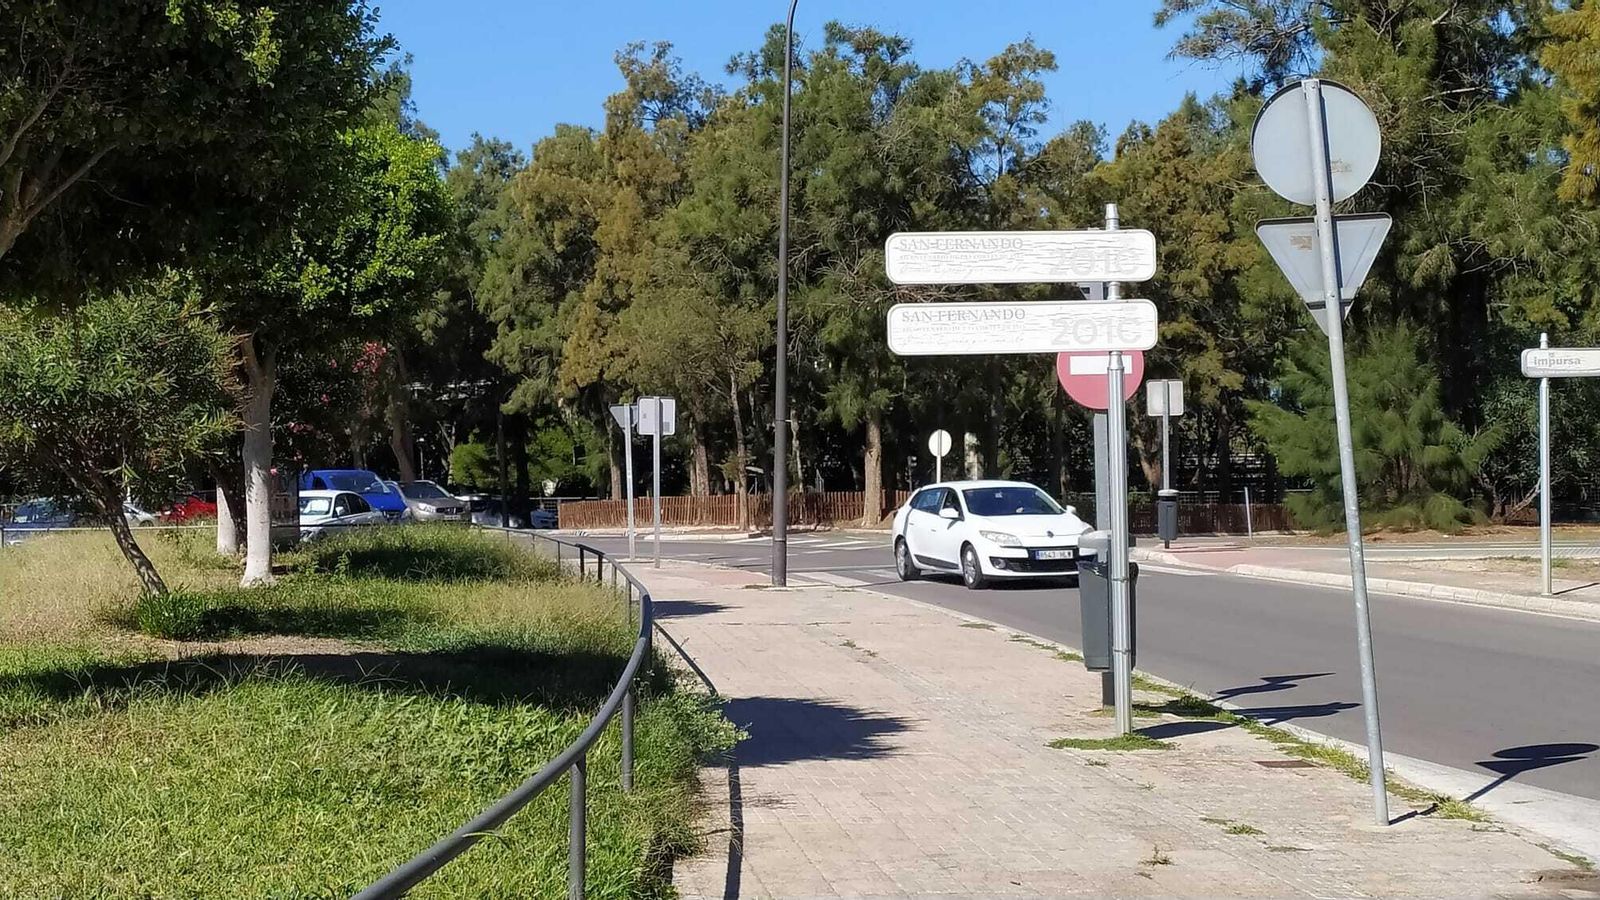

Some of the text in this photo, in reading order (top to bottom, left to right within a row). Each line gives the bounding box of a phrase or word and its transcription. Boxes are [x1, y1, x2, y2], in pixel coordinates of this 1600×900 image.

[899, 237, 1023, 250] SAN FERNANDO
[902, 308, 1026, 322] SAN FERNANDO
